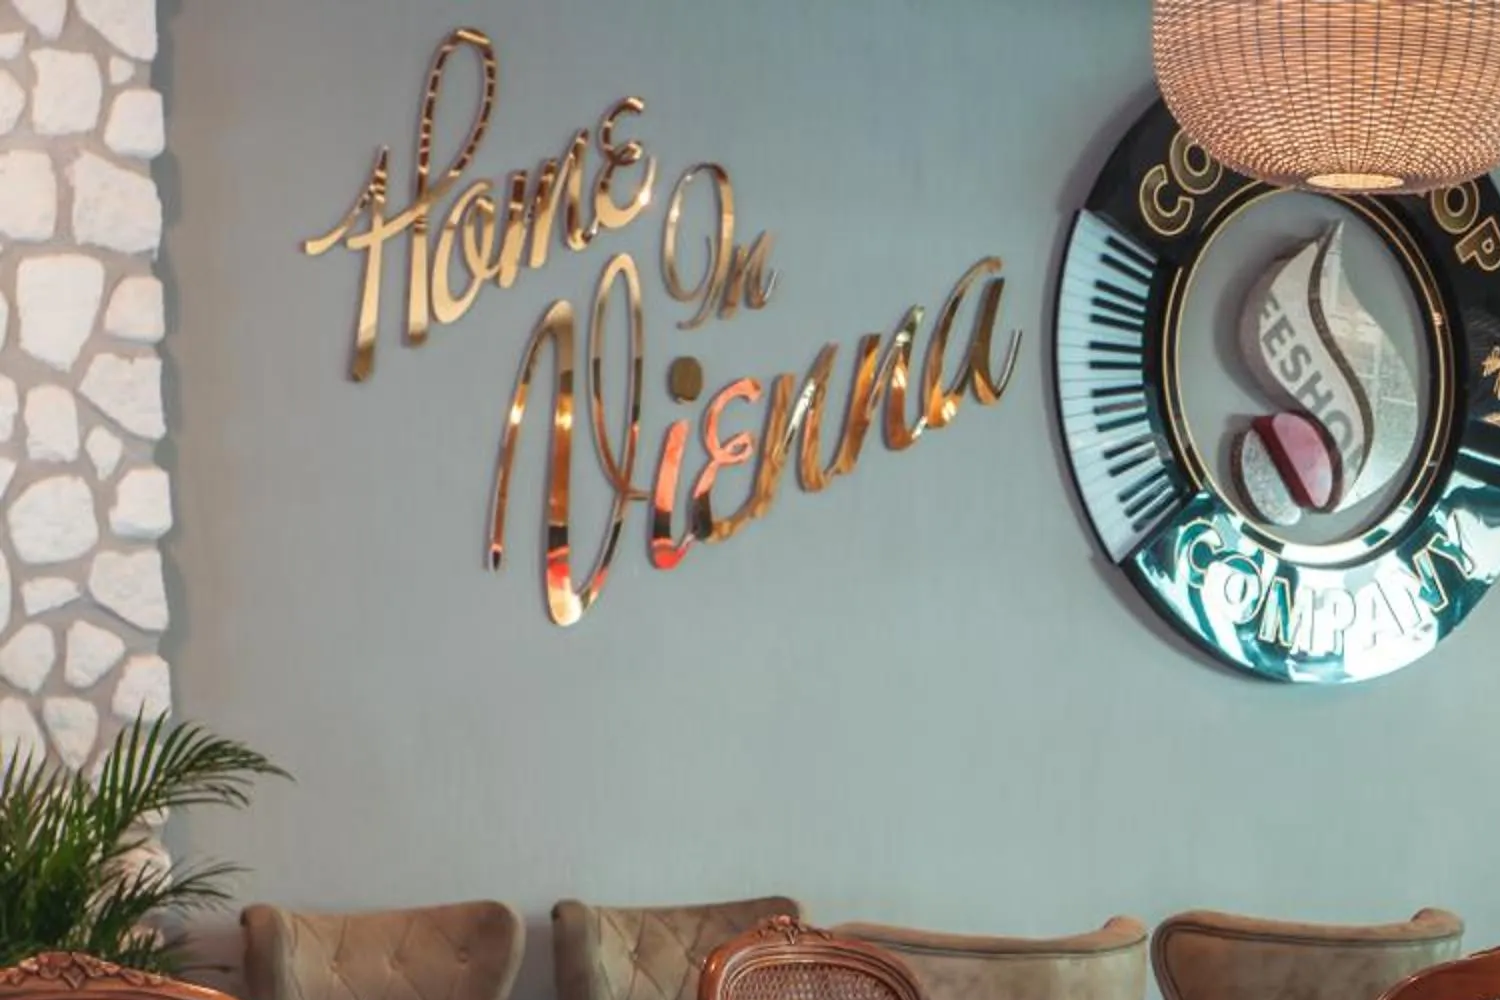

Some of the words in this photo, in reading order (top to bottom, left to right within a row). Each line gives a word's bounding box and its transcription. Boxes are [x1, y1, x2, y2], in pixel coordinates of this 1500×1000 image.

[300, 27, 656, 383] Home
[486, 253, 1023, 627] Vienna
[1174, 511, 1475, 656] COMPANY
